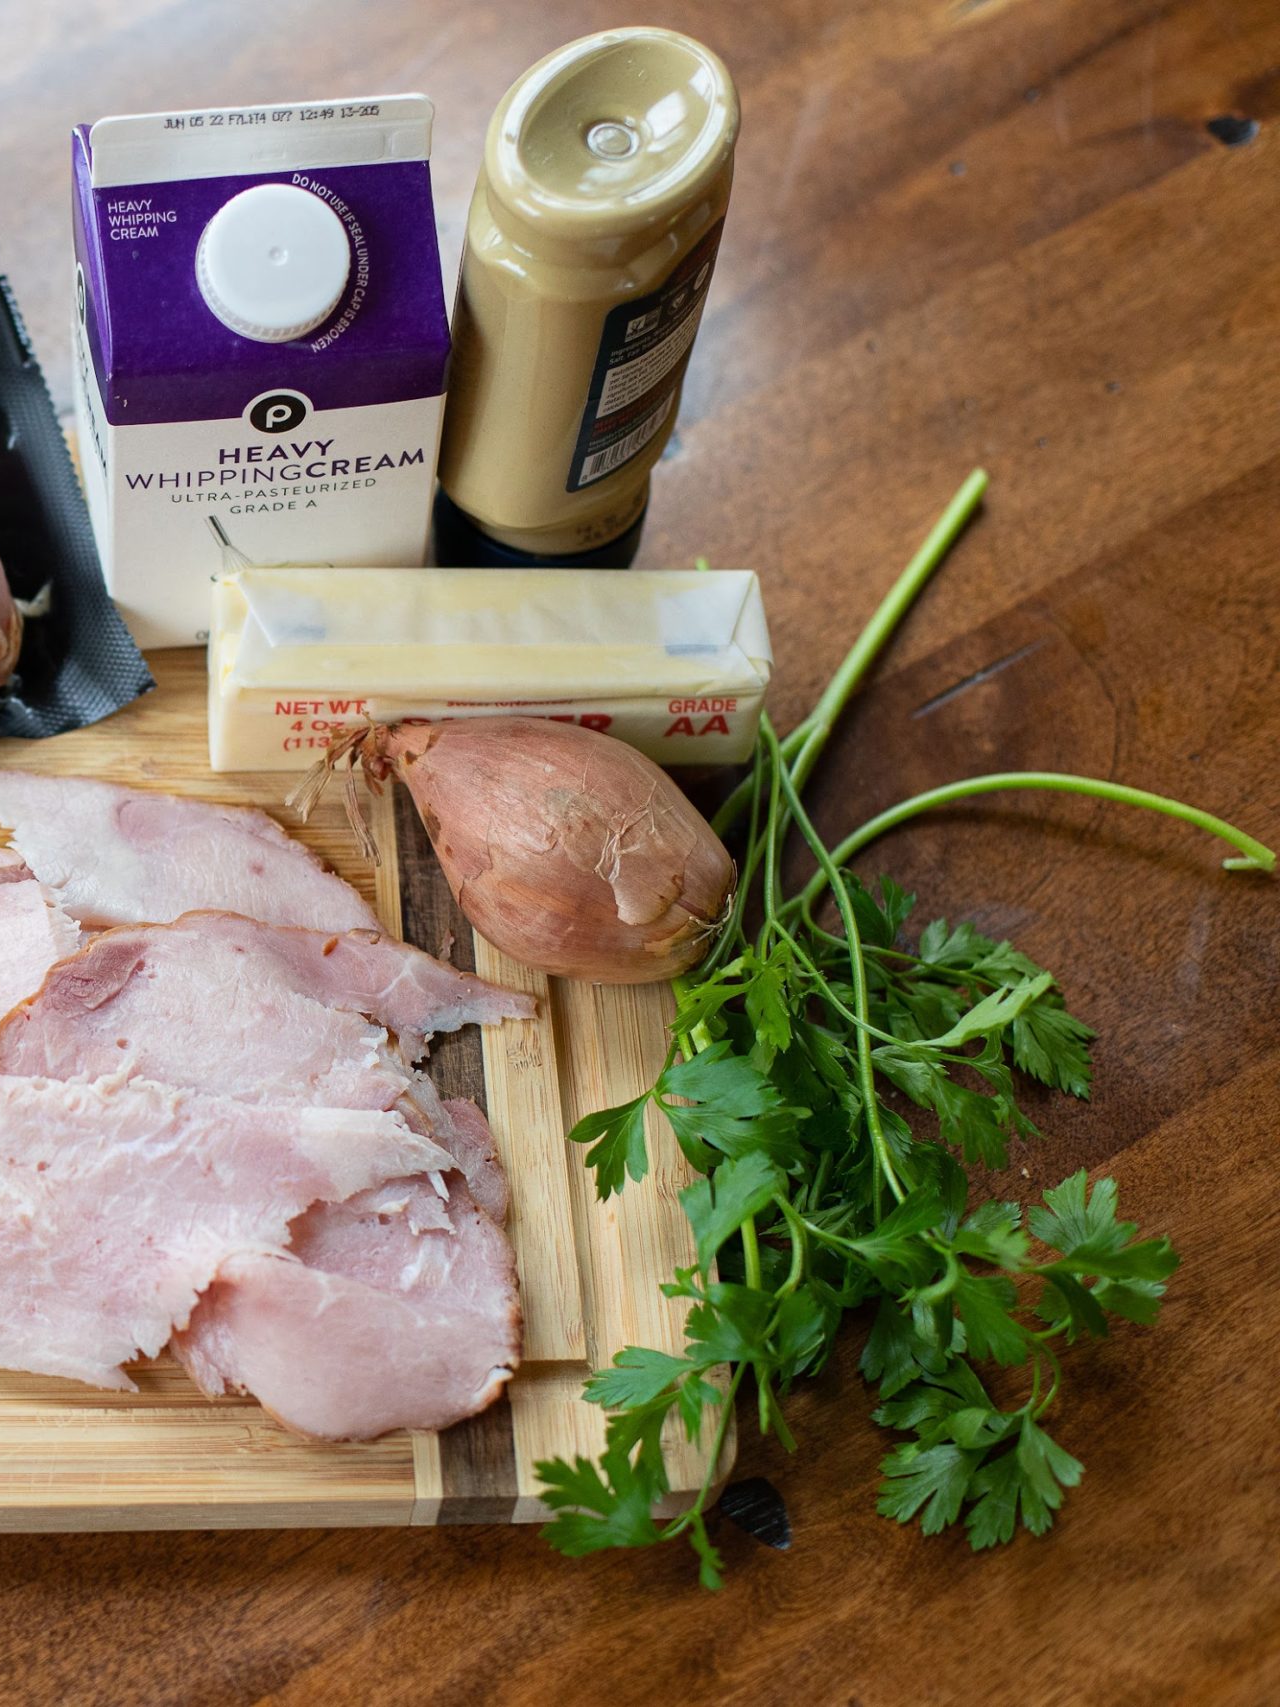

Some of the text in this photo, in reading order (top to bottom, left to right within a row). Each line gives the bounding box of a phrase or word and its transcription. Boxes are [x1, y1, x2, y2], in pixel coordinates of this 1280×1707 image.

[163, 118, 185, 130] JUN
[209, 115, 224, 126] 22
[300, 107, 335, 121] 12:49
[108, 199, 152, 214] HEAVY
[108, 211, 178, 227] WHIPPING
[110, 226, 159, 240] CREAM
[292, 173, 369, 353] DO NOT USE IF SEAL UNDER CAP IS BROKEN
[219, 438, 335, 465] HEAVY
[172, 478, 377, 503] ULTRA-PASTEURIZED
[230, 500, 318, 515] GRADE A
[275, 700, 367, 715] NET WT
[668, 697, 737, 713] GRADE
[290, 720, 303, 732] 4
[663, 714, 730, 737] AA
